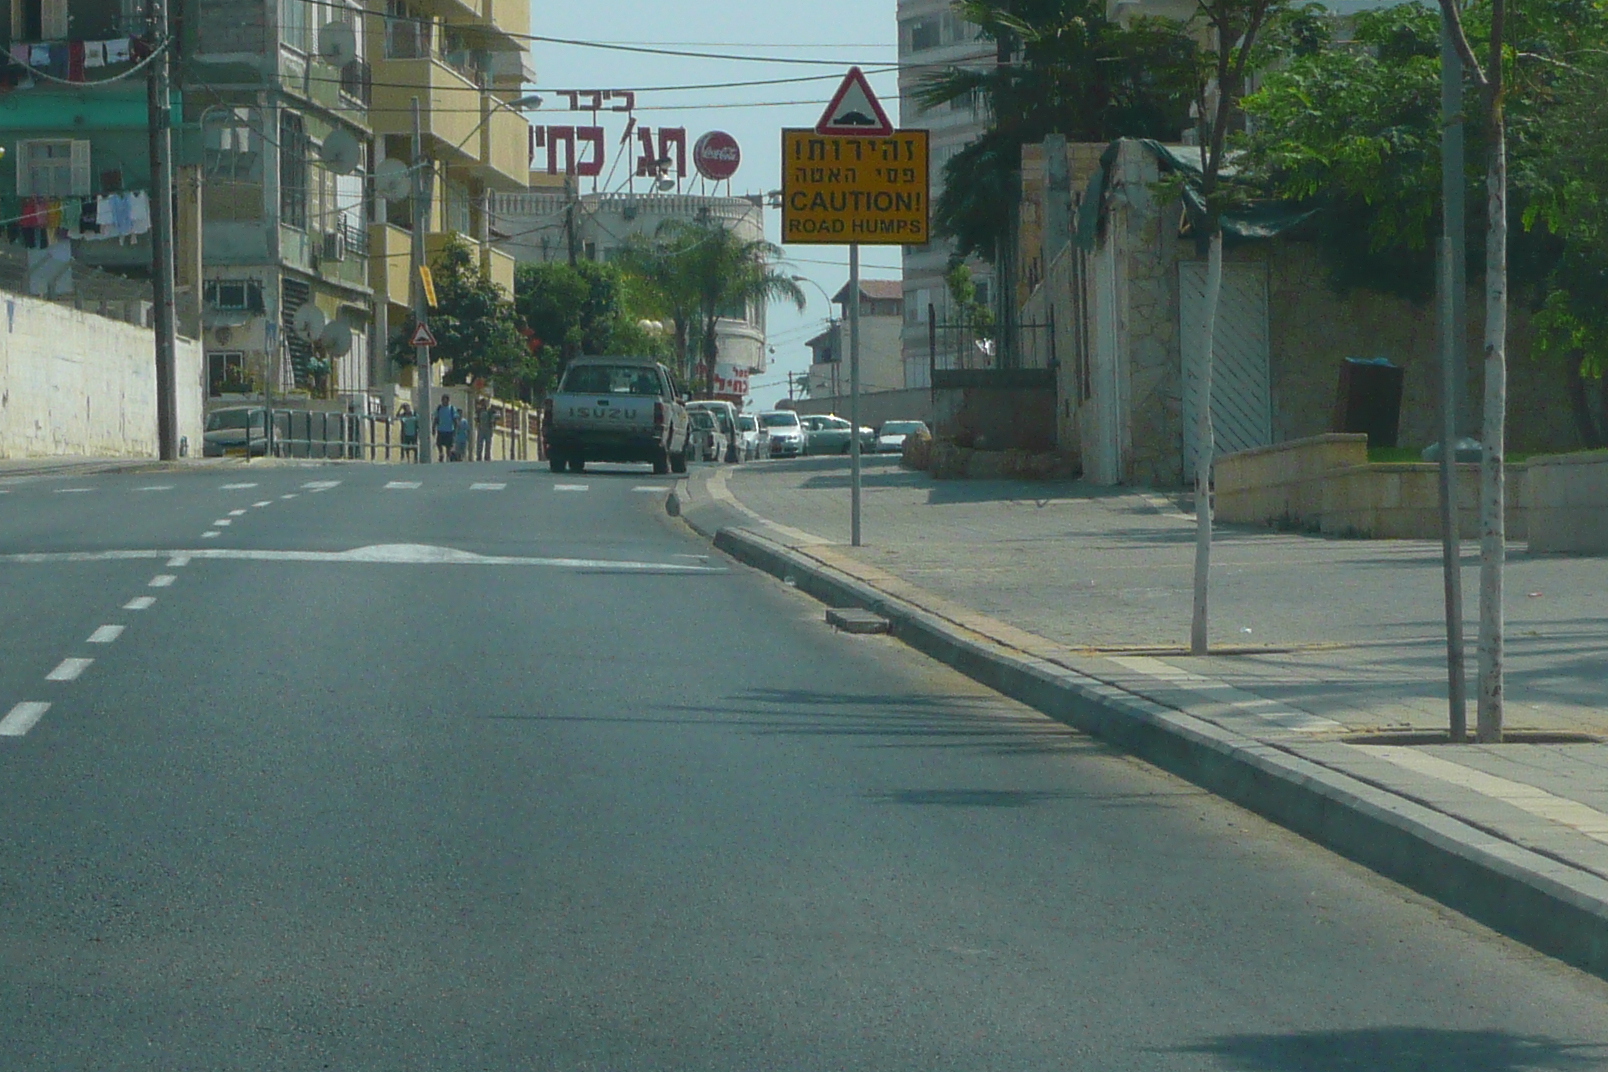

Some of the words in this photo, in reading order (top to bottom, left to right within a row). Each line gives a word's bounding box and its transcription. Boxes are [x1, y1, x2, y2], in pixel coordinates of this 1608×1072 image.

[795, 139, 914, 161] זהירות!
[795, 167, 857, 184] האטה
[875, 167, 915, 184] פסי
[790, 190, 921, 212] CAUTION!
[789, 219, 845, 234] ROAD
[852, 218, 921, 234] HUMPS
[569, 407, 637, 420] ISUZU
